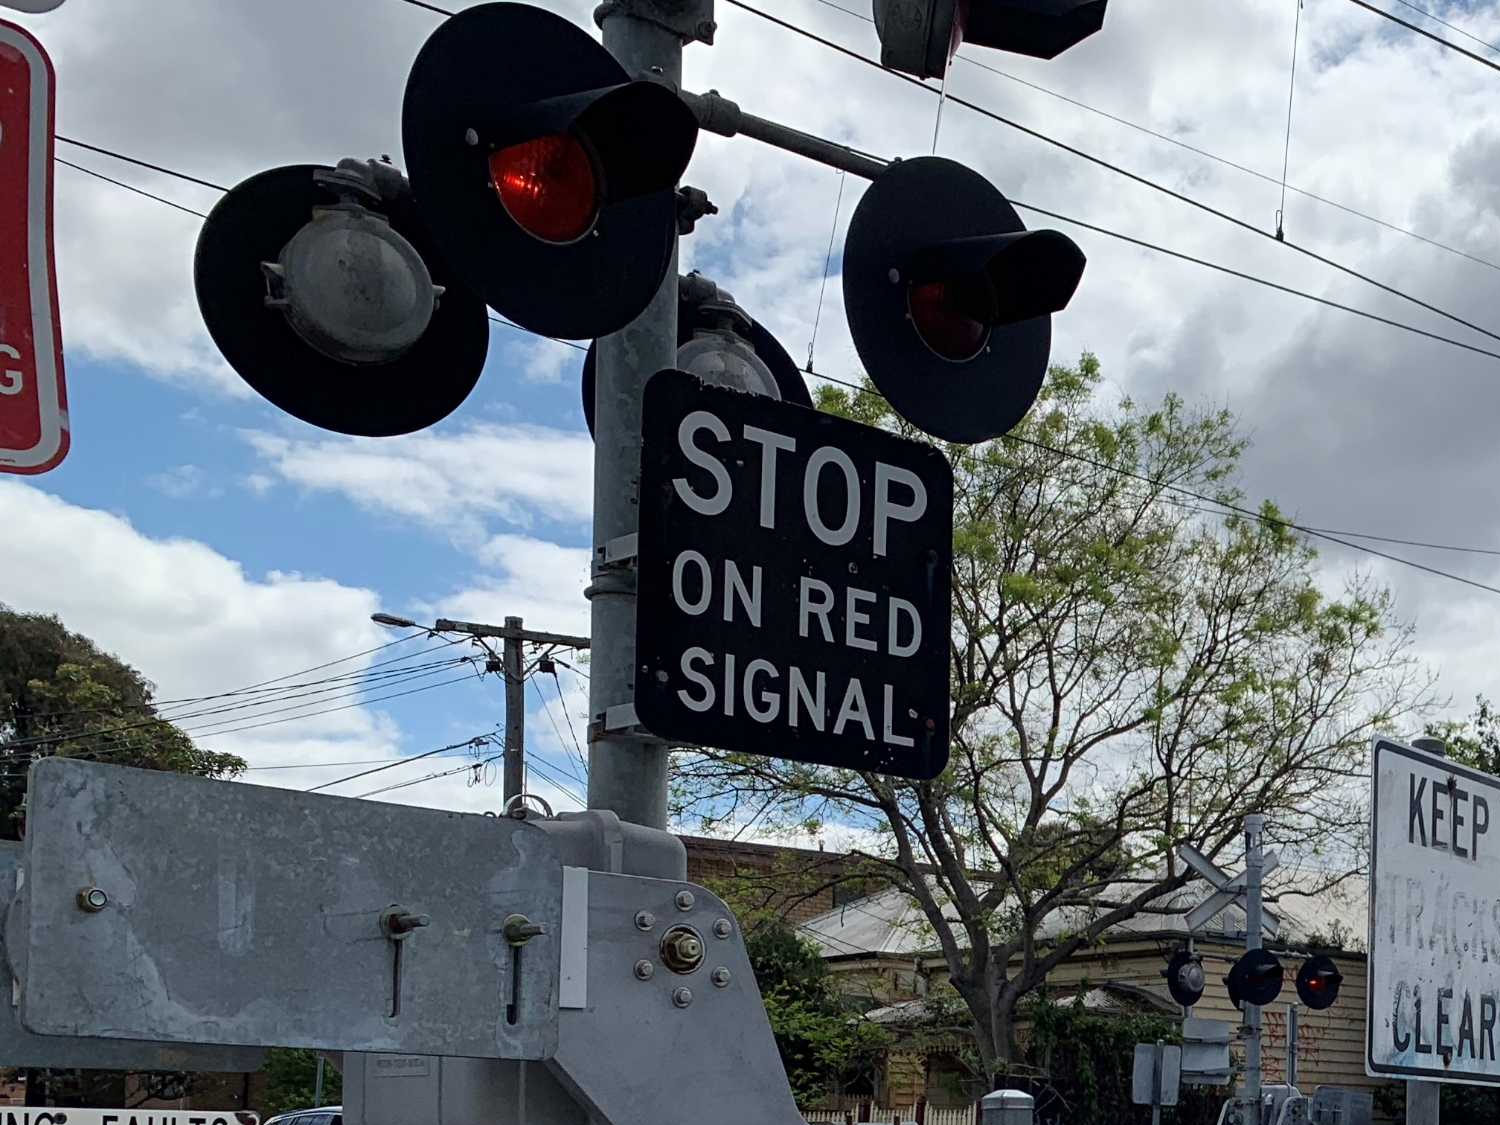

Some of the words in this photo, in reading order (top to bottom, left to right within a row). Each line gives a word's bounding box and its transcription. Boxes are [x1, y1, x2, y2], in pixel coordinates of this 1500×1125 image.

[672, 410, 928, 557] STOP
[672, 550, 762, 628] ON
[799, 576, 922, 658] RED
[677, 646, 915, 747] SIGNAL
[1408, 773, 1489, 861] KEEP
[1392, 980, 1496, 1061] CLEAR
